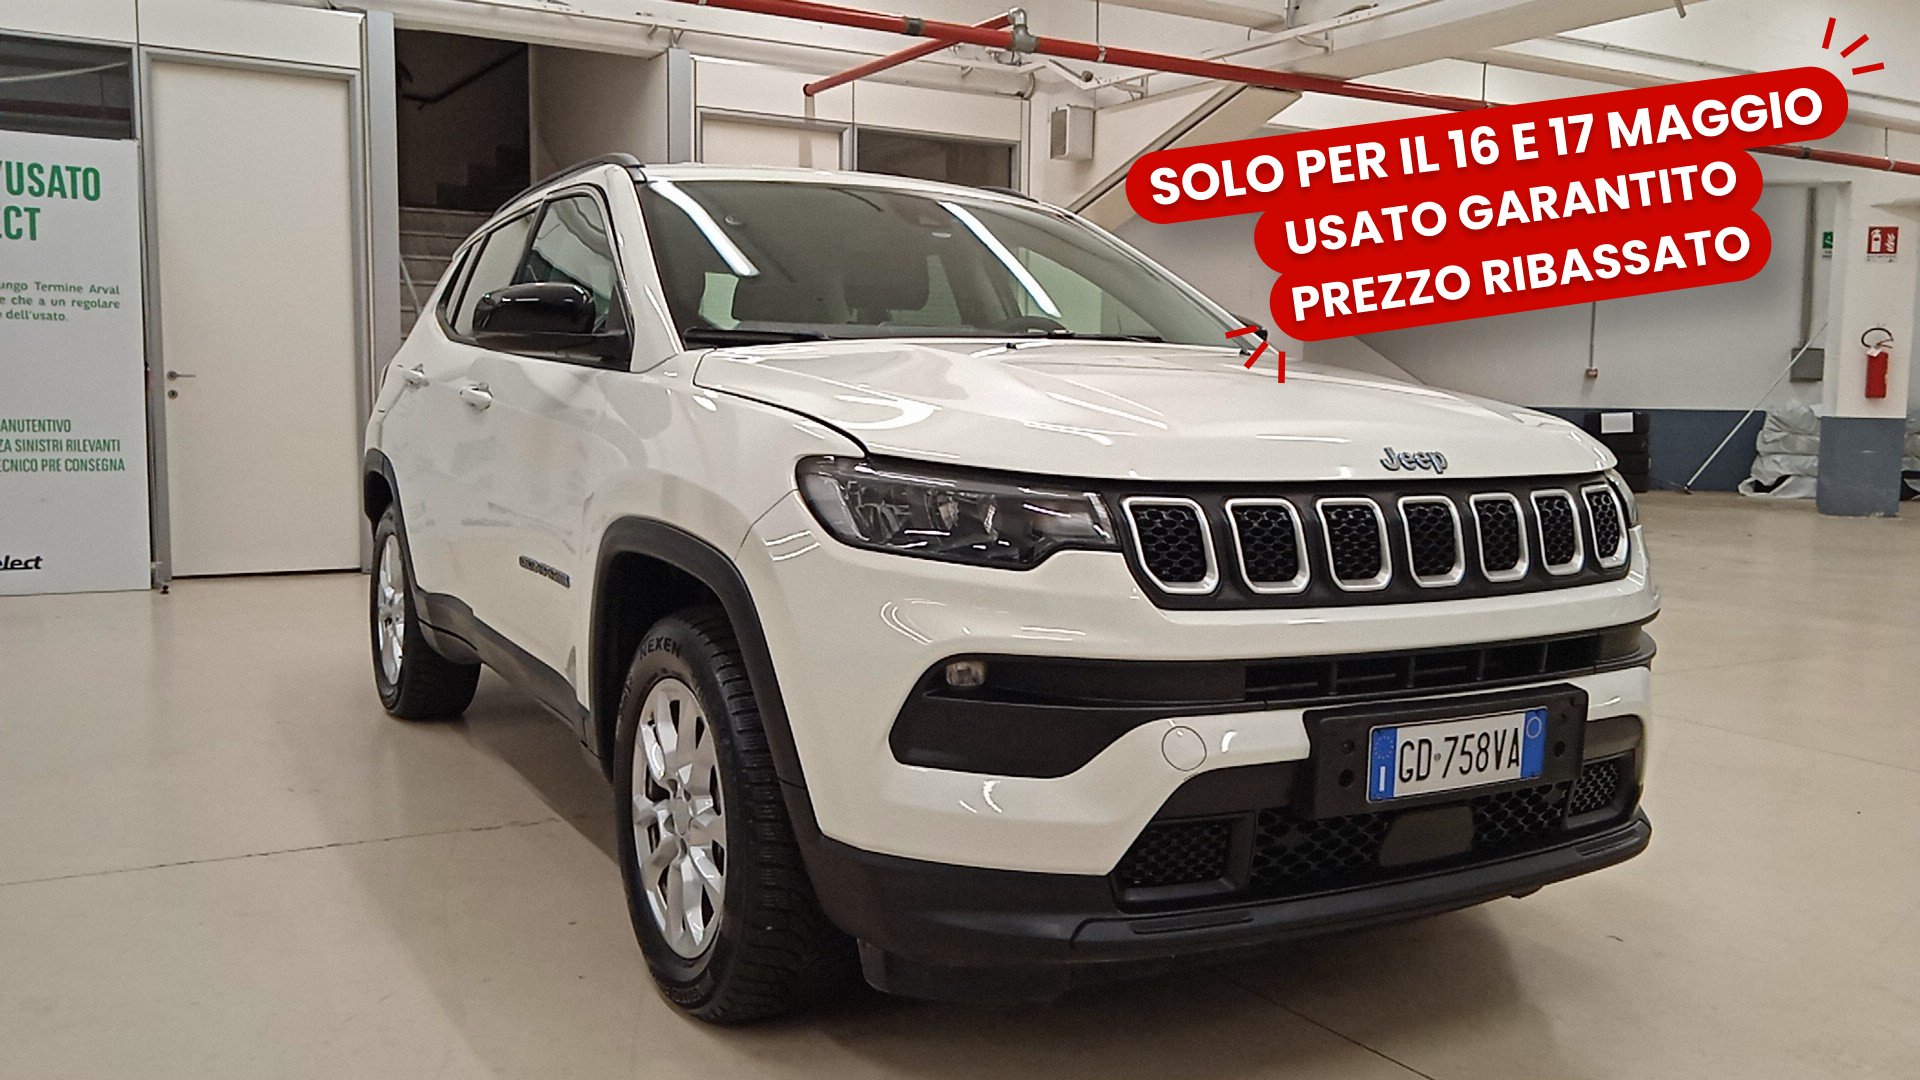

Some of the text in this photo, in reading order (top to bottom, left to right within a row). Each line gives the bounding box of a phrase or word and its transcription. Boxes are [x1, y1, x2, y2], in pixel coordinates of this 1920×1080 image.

[34, 281, 83, 293] Termine
[89, 284, 120, 295] Arval
[11, 295, 33, 306] che
[38, 298, 46, 306] a
[50, 299, 66, 307] un
[71, 299, 120, 310] regolare
[15, 439, 63, 452] SINISTRI
[66, 439, 120, 453] RILEVANTI
[41, 458, 62, 472] PRE
[65, 458, 125, 472] CONSEGNA
[1380, 447, 1448, 474] Jeep
[641, 637, 681, 660] NEXEN
